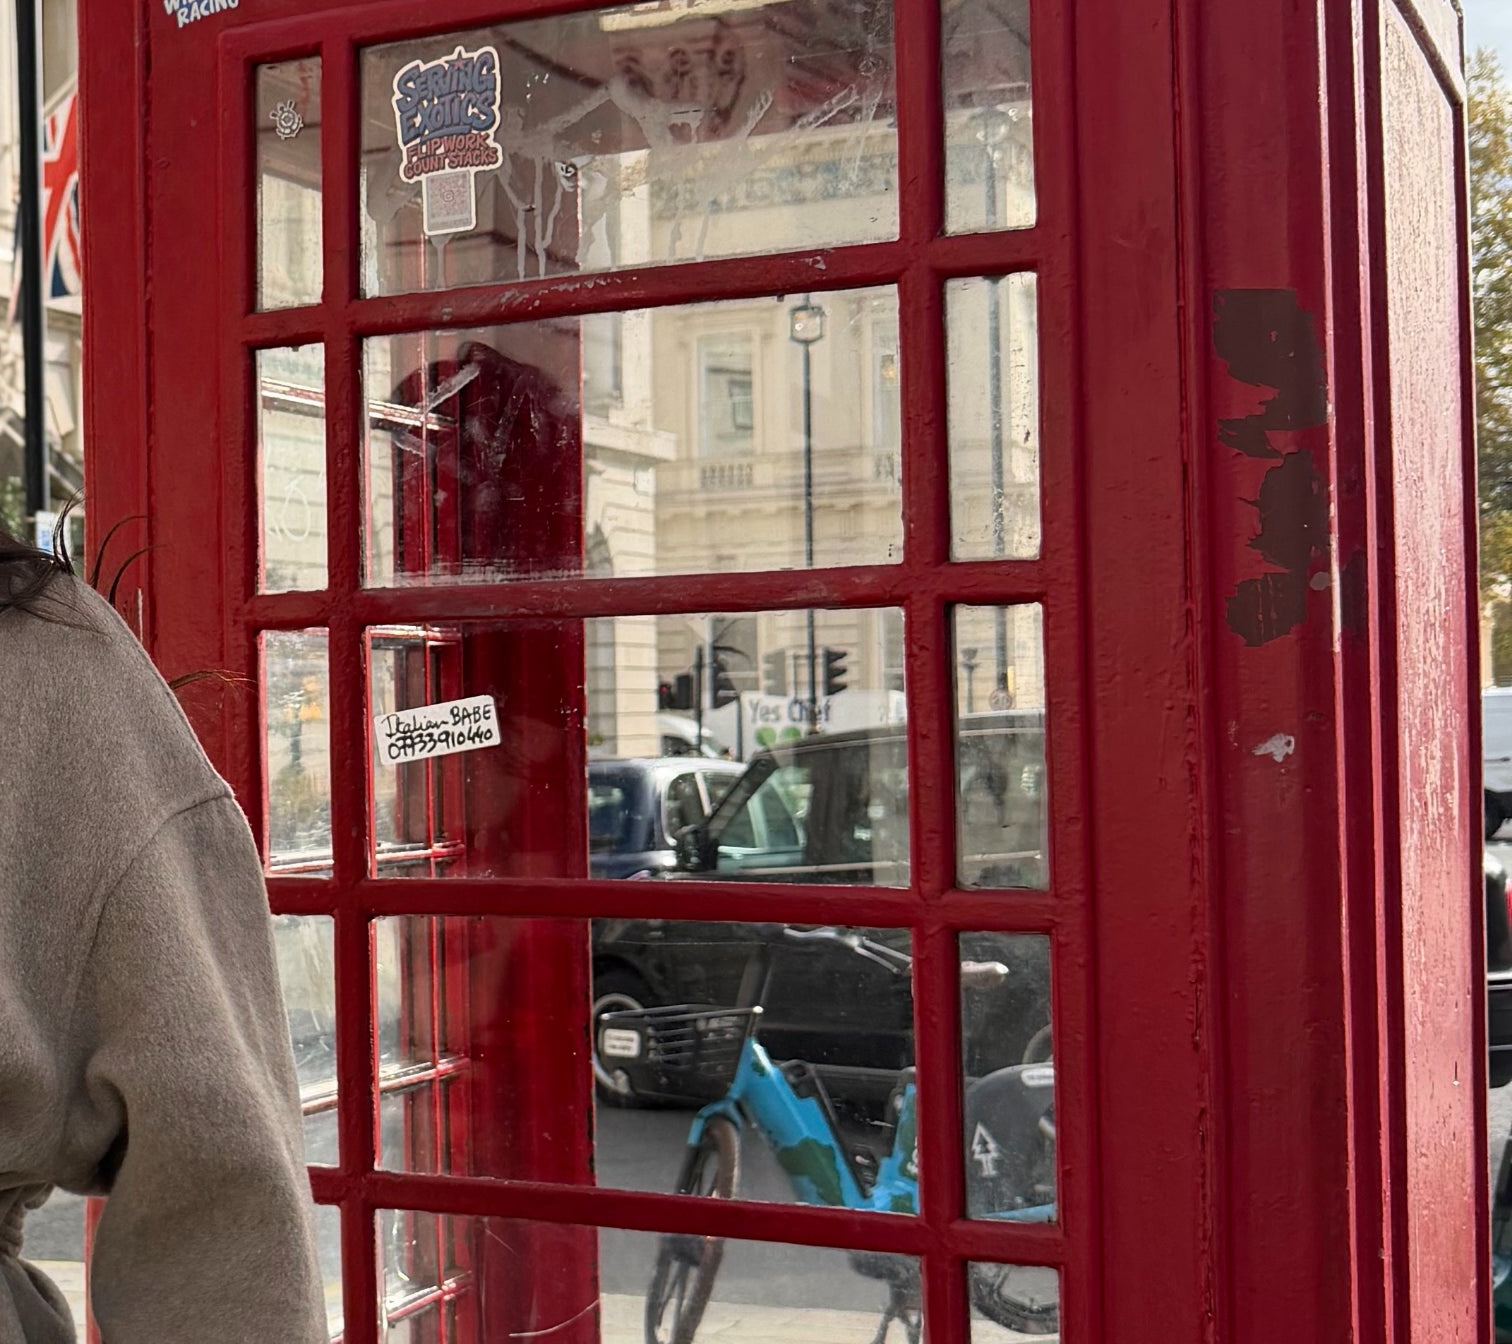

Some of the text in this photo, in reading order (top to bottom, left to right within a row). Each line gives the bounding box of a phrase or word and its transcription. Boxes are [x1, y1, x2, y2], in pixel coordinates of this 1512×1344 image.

[396, 51, 496, 114] SERVING
[399, 93, 496, 146] EXOTICS
[404, 147, 498, 179] COUNT STACKS
[406, 132, 490, 163] FLIP WORK
[450, 704, 493, 726] BABE
[749, 699, 780, 723] Yes
